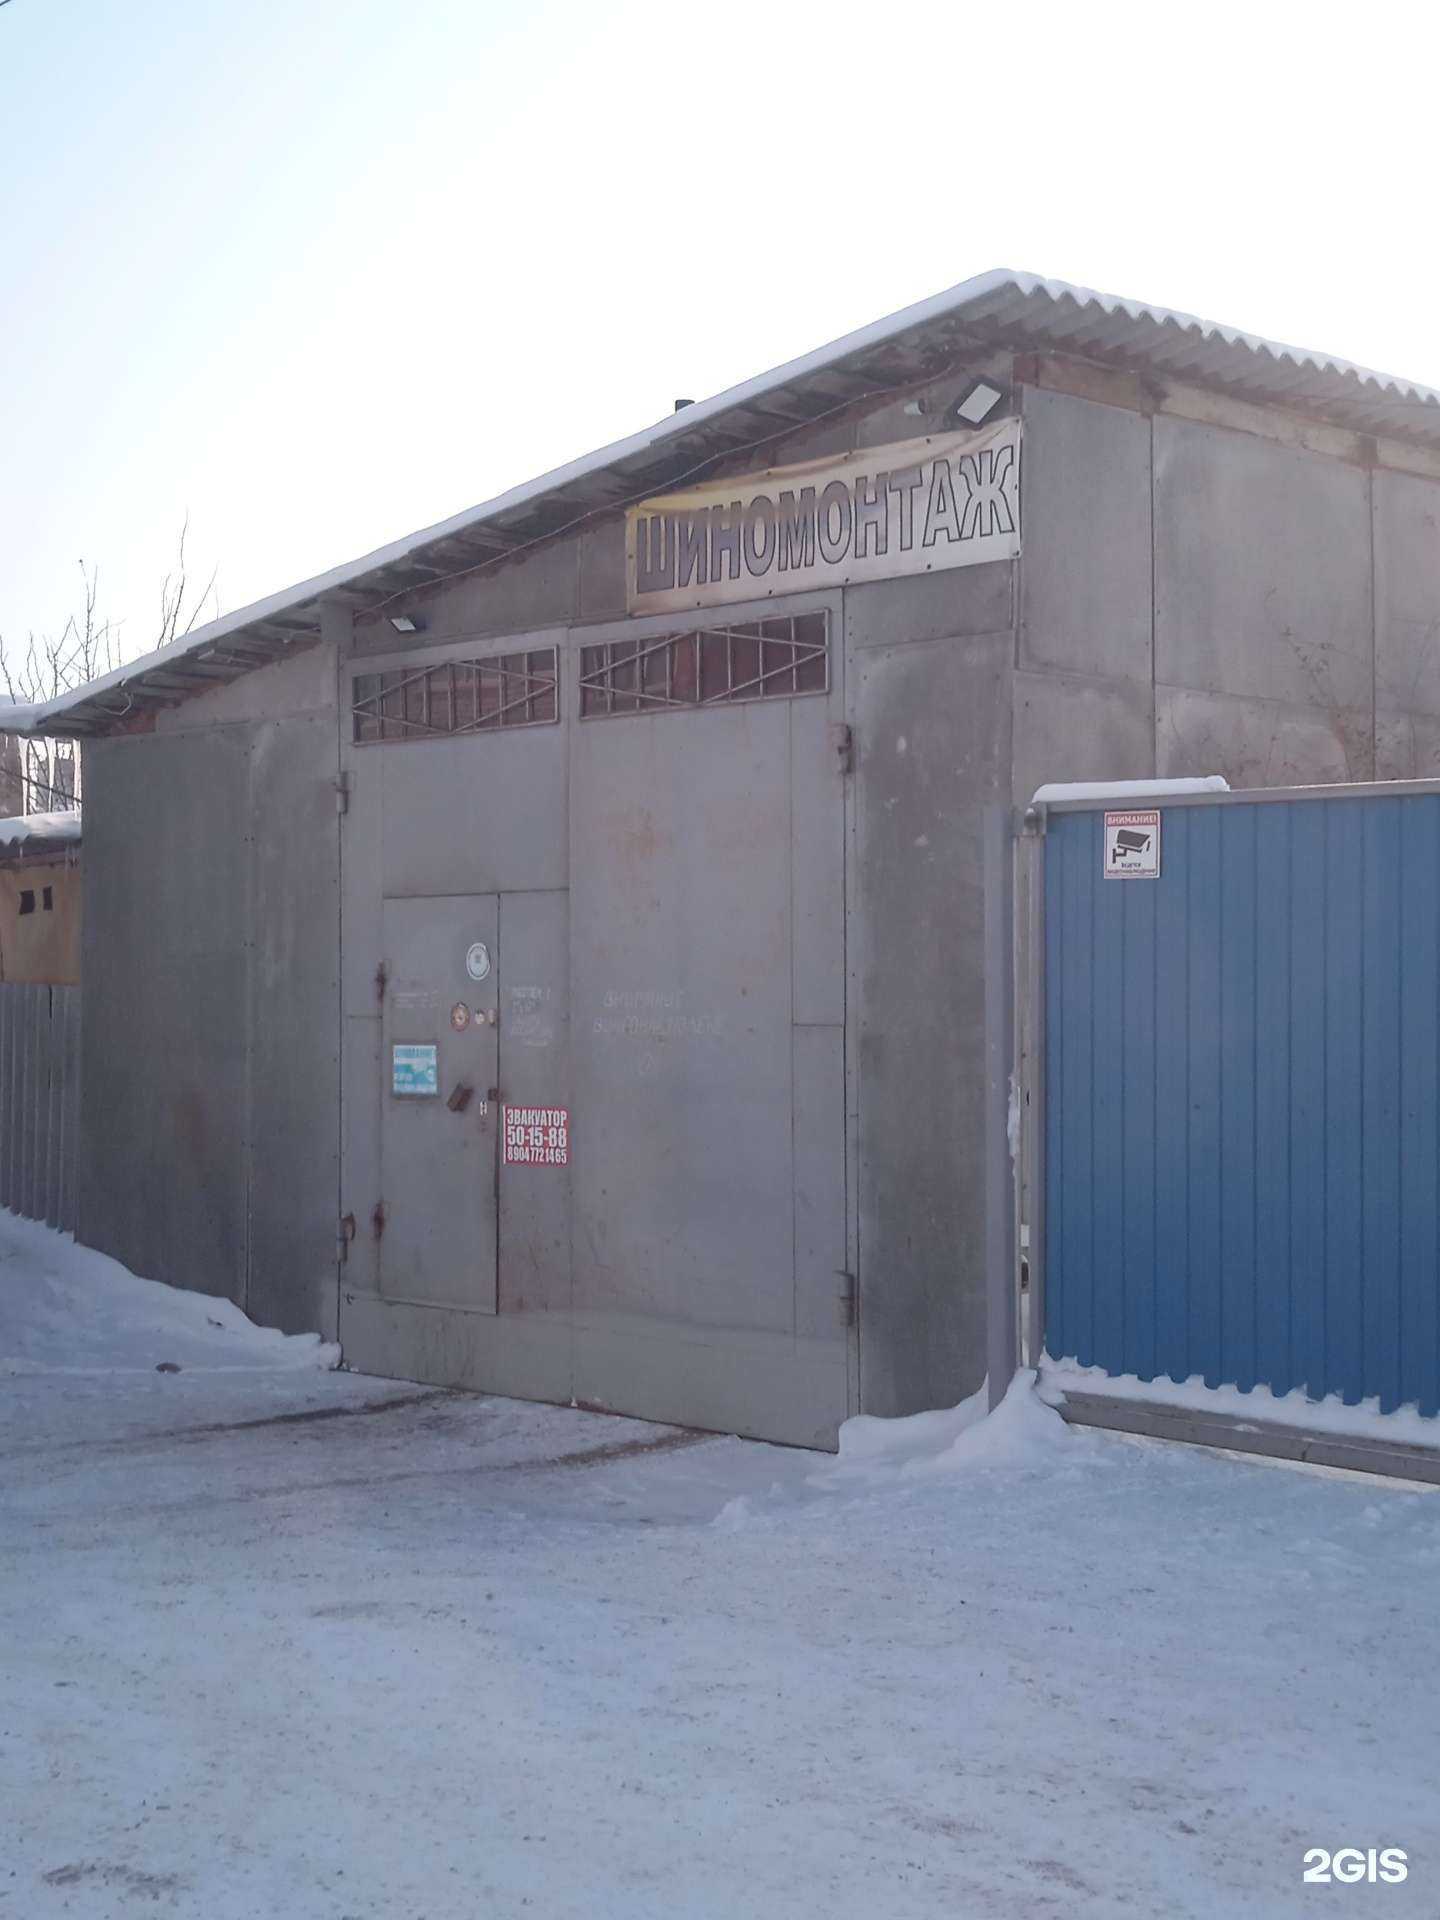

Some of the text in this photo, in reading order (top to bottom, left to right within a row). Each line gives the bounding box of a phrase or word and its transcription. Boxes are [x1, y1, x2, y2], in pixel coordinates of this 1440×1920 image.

[636, 444, 1015, 595] ШИНОМОНТАЖ
[507, 1108, 567, 1127] ЭВАКУАТОР
[507, 1126, 567, 1148] 50-15-88
